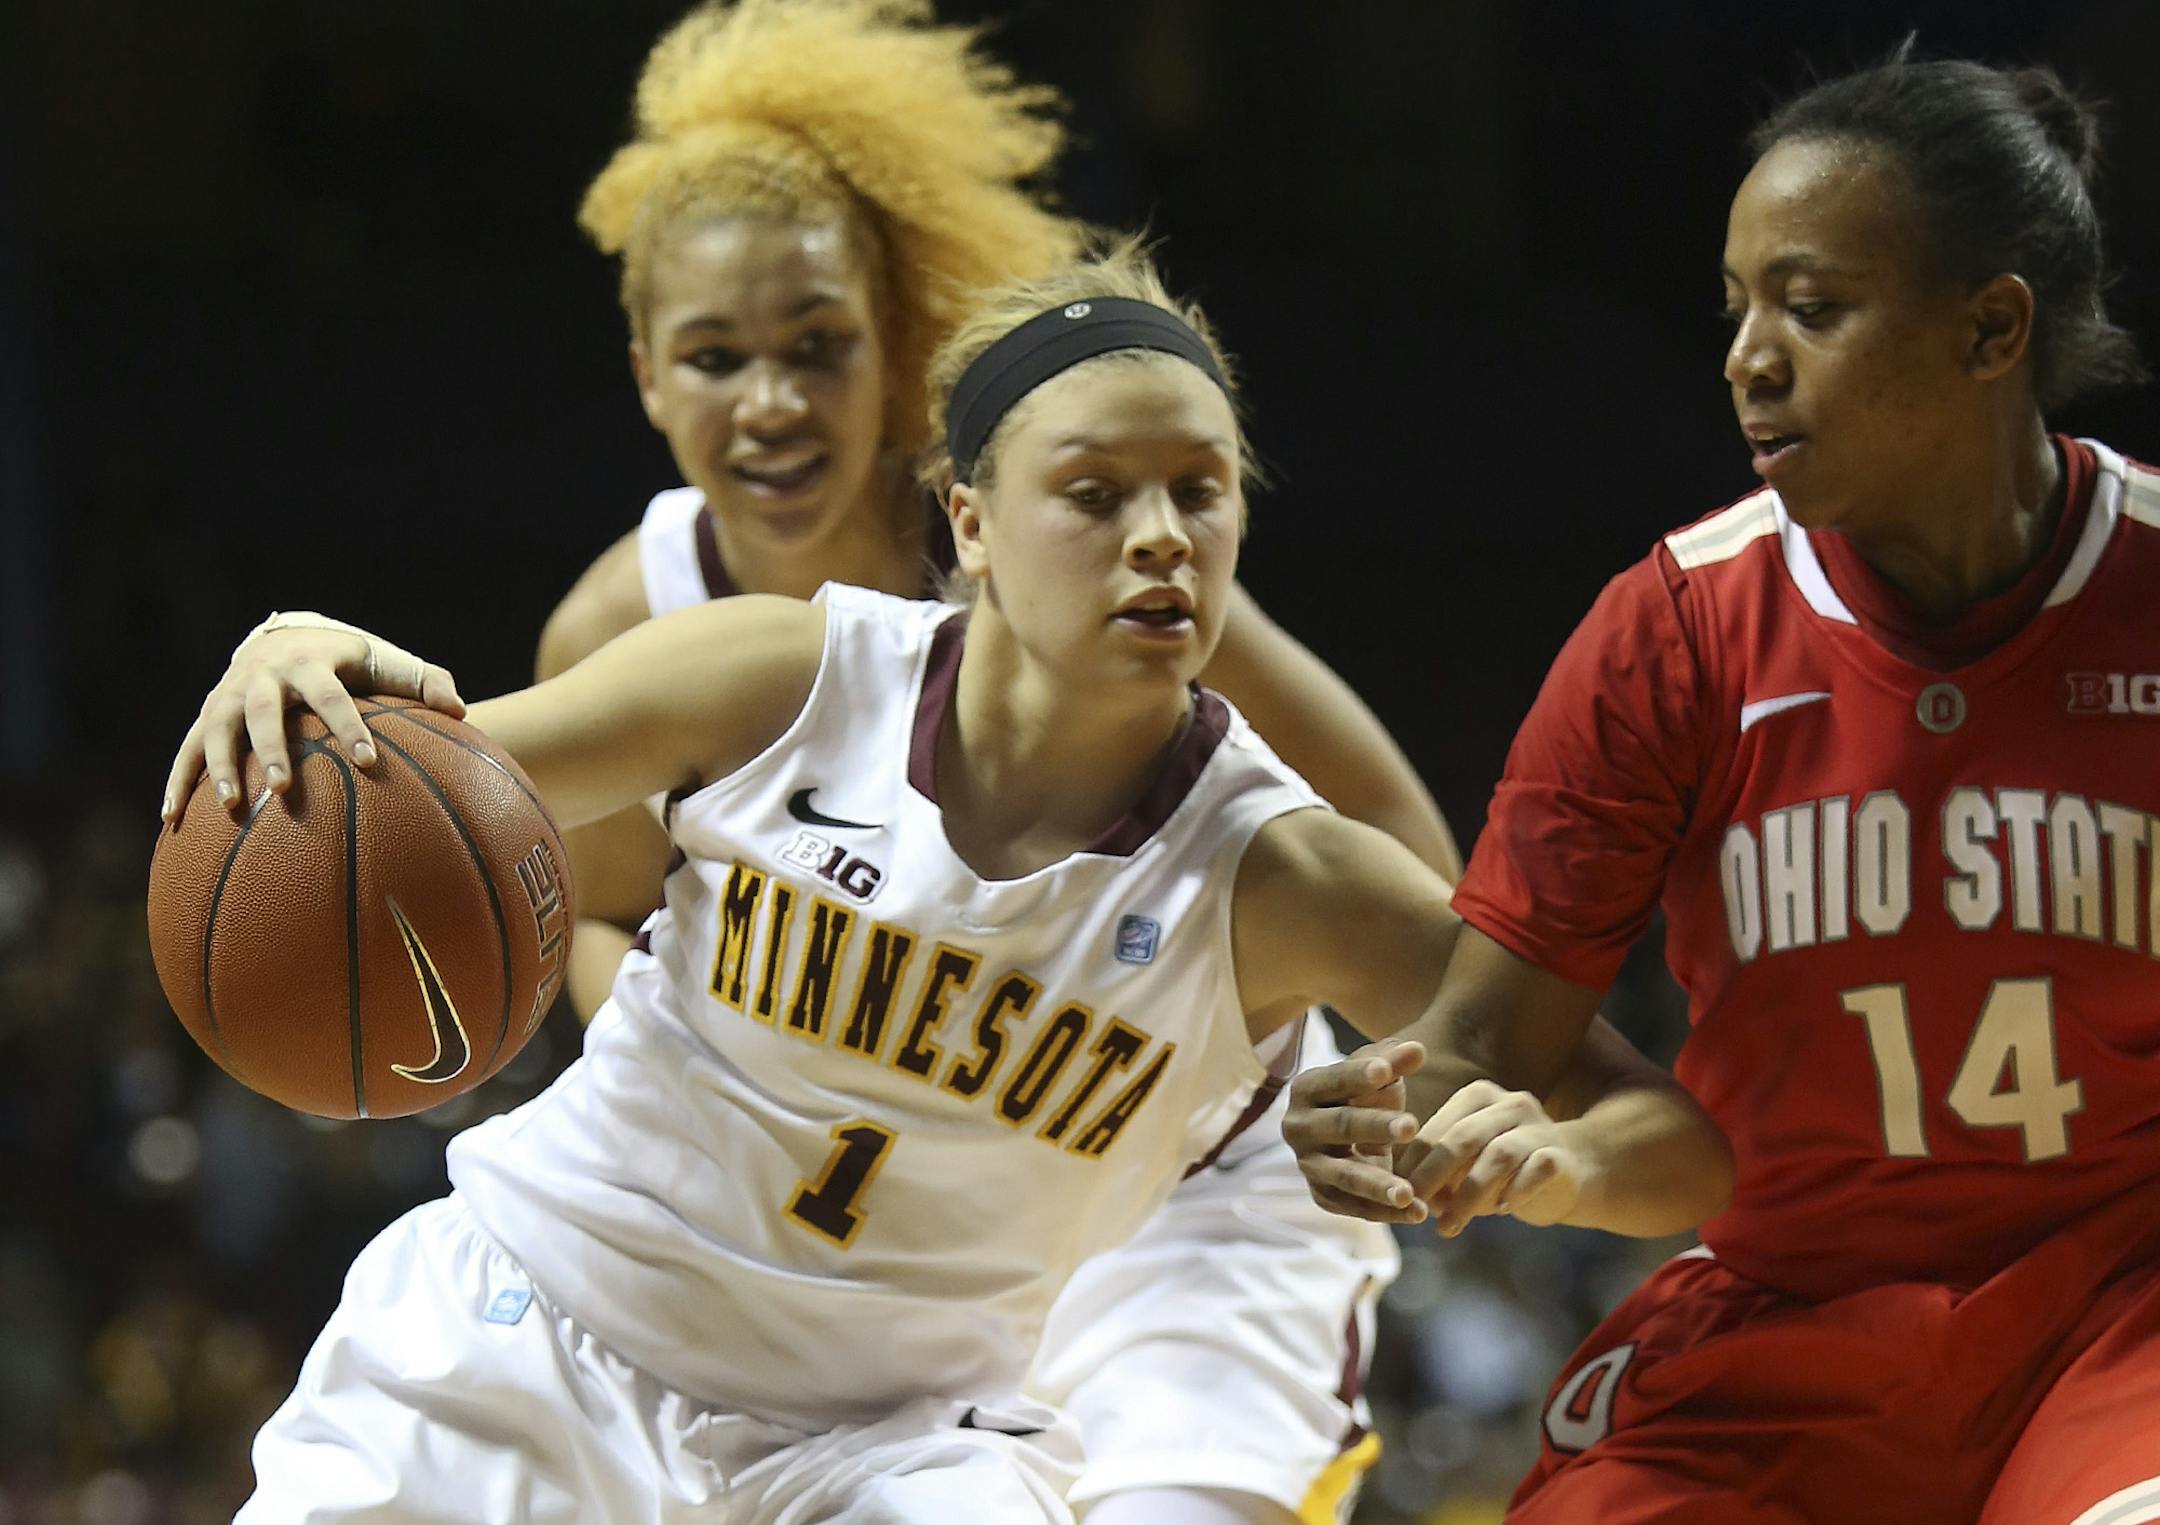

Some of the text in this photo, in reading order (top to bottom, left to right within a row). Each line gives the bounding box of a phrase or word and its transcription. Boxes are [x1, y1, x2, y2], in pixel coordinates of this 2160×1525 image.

[1720, 786, 2160, 965] OHIO STAT
[709, 859, 1177, 1160] MINNESOTA
[1838, 976, 2085, 1164] 14
[784, 1119, 898, 1251] 1
